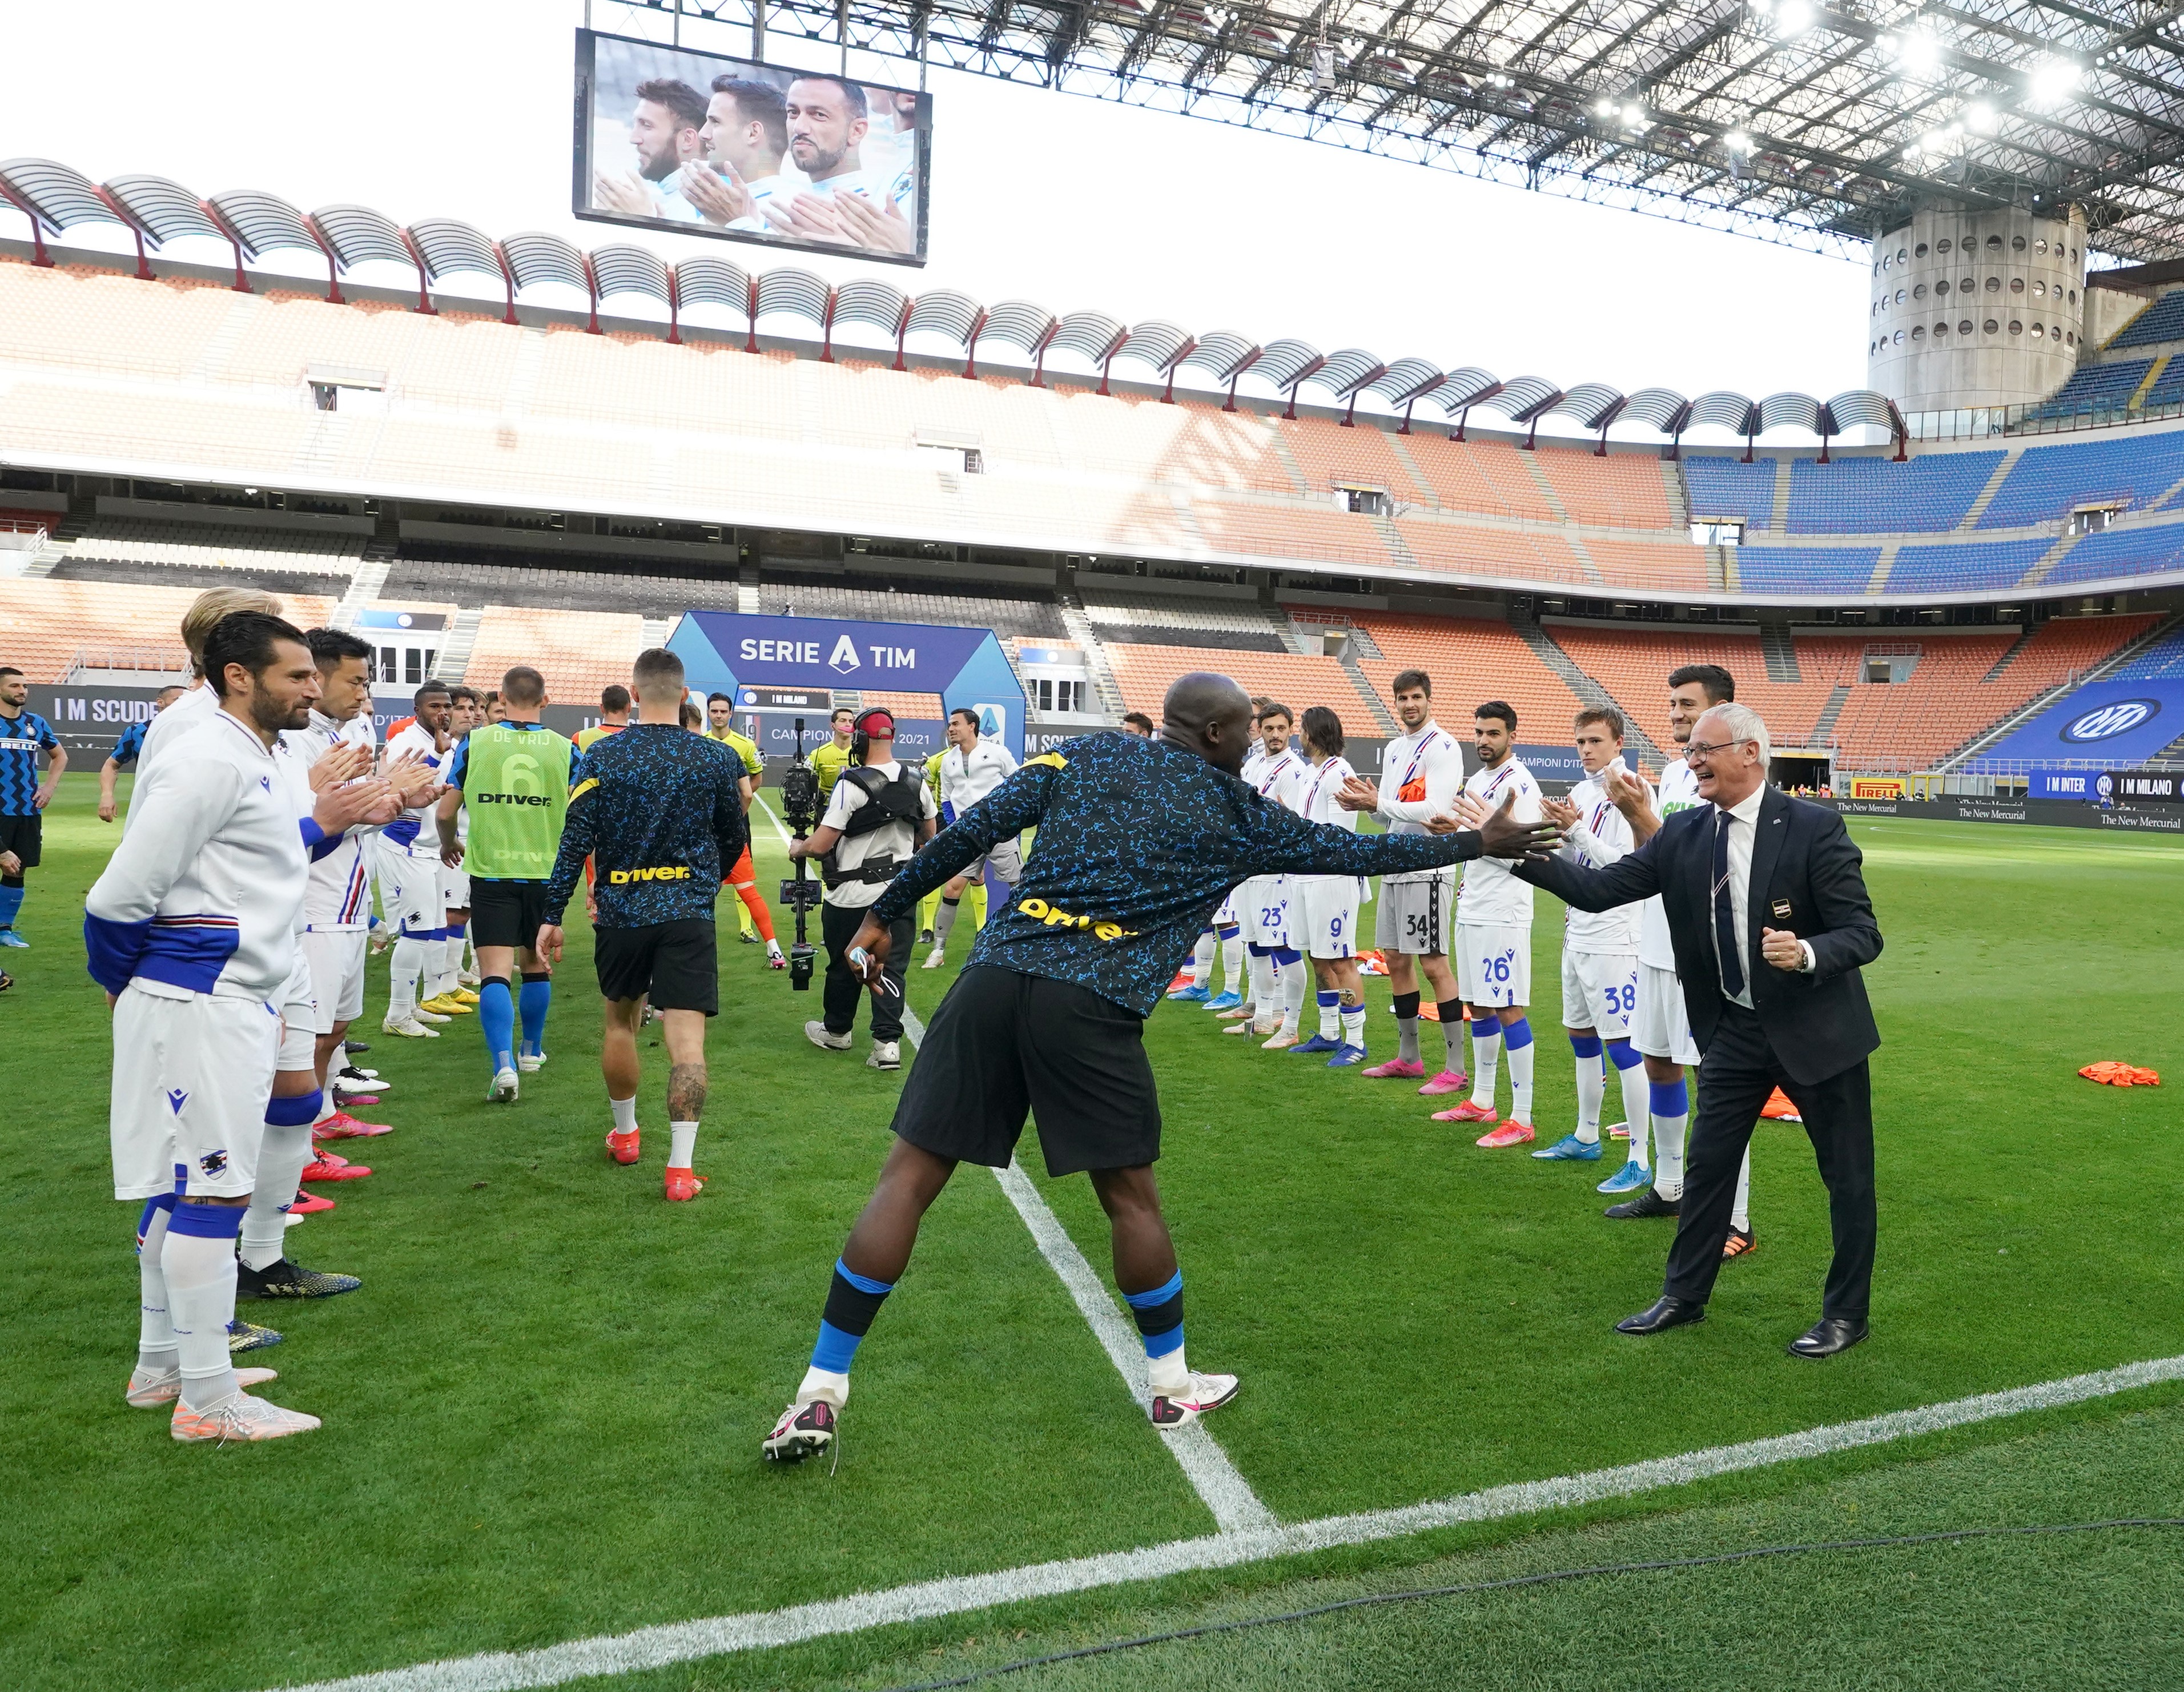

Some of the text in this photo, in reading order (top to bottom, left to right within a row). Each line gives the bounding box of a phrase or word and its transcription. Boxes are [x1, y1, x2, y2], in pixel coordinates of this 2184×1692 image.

[739, 638, 820, 664] SERIE
[869, 646, 915, 669] TIM
[54, 697, 62, 720] I
[67, 698, 86, 721] M
[783, 694, 808, 705] MILANO
[493, 730, 550, 746] DE VRIJ
[899, 734, 930, 745] 20/21
[1024, 734, 1037, 753] M
[501, 753, 540, 812] 6
[2046, 777, 2085, 793] I M INTER
[2121, 778, 2173, 796] I M MILANO
[1837, 802, 1897, 813] The New Mercurial
[1958, 807, 2026, 820] The New Mercurial
[2101, 814, 2181, 829] The New Mercurial
[1261, 907, 1282, 927] 23
[1406, 914, 1429, 937] 34
[1330, 917, 1342, 938] 9
[1482, 956, 1510, 983] 26
[1604, 983, 1635, 1015] 38
